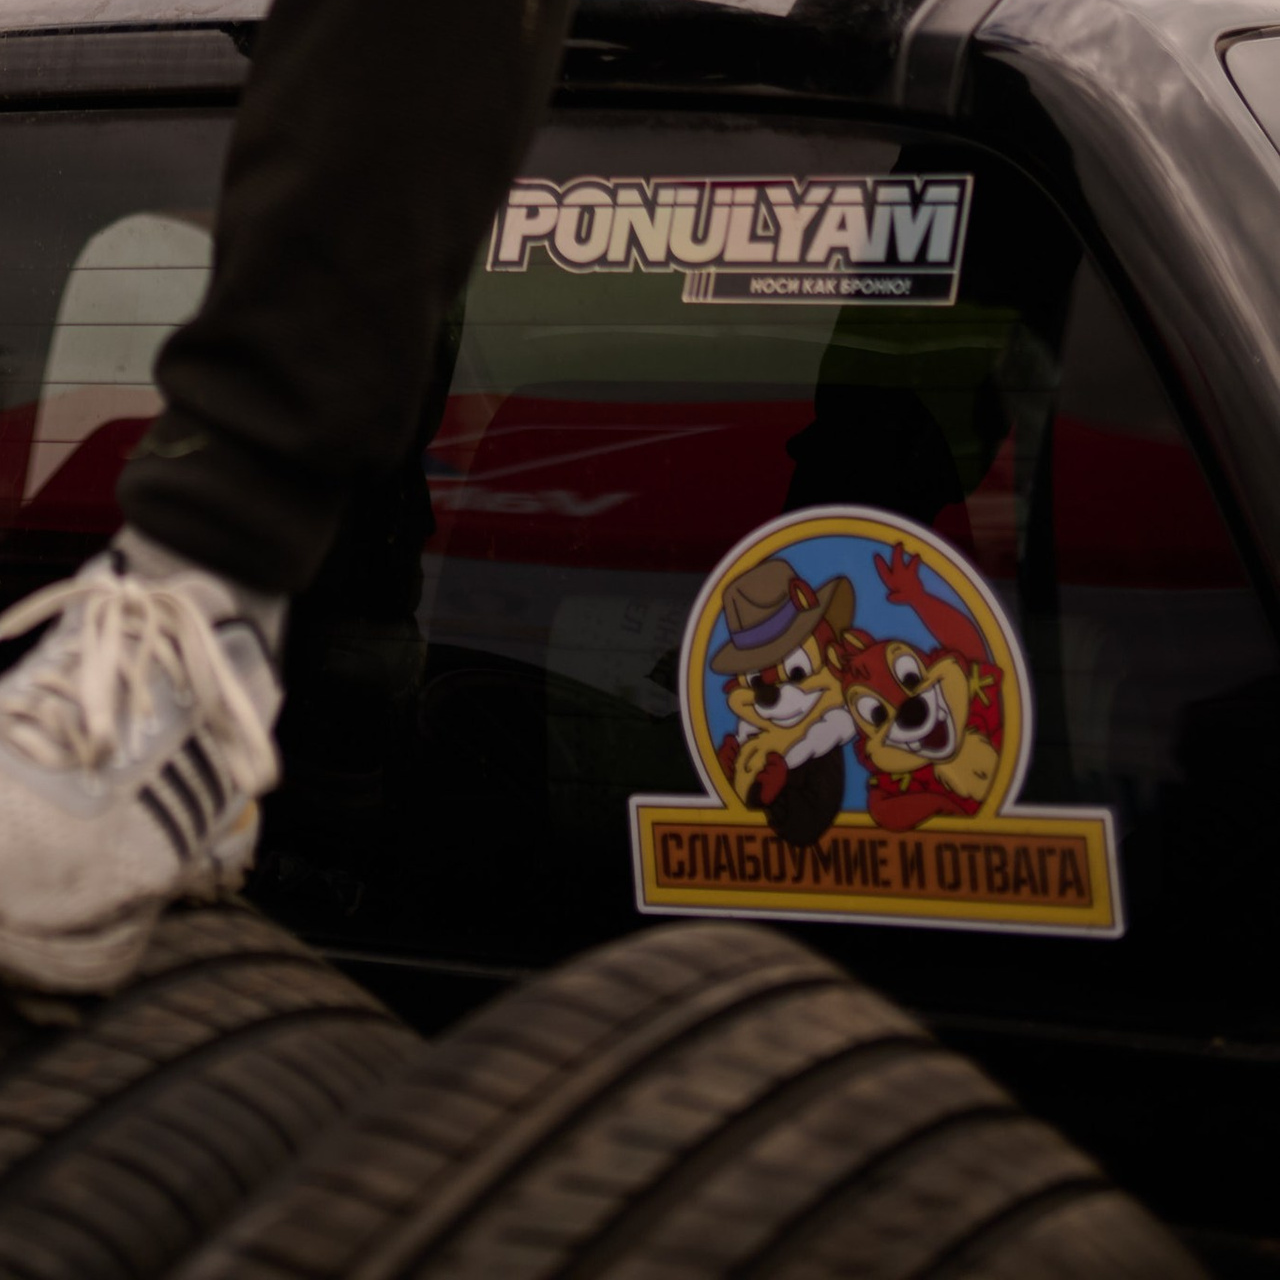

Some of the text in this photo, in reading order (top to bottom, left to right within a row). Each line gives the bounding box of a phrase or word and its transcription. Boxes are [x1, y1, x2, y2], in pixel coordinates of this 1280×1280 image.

[497, 184, 960, 265] PONULYAM
[802, 276, 838, 295] КАК
[659, 830, 1087, 899] СЛАБОУМИЕ И ОТВАГА
